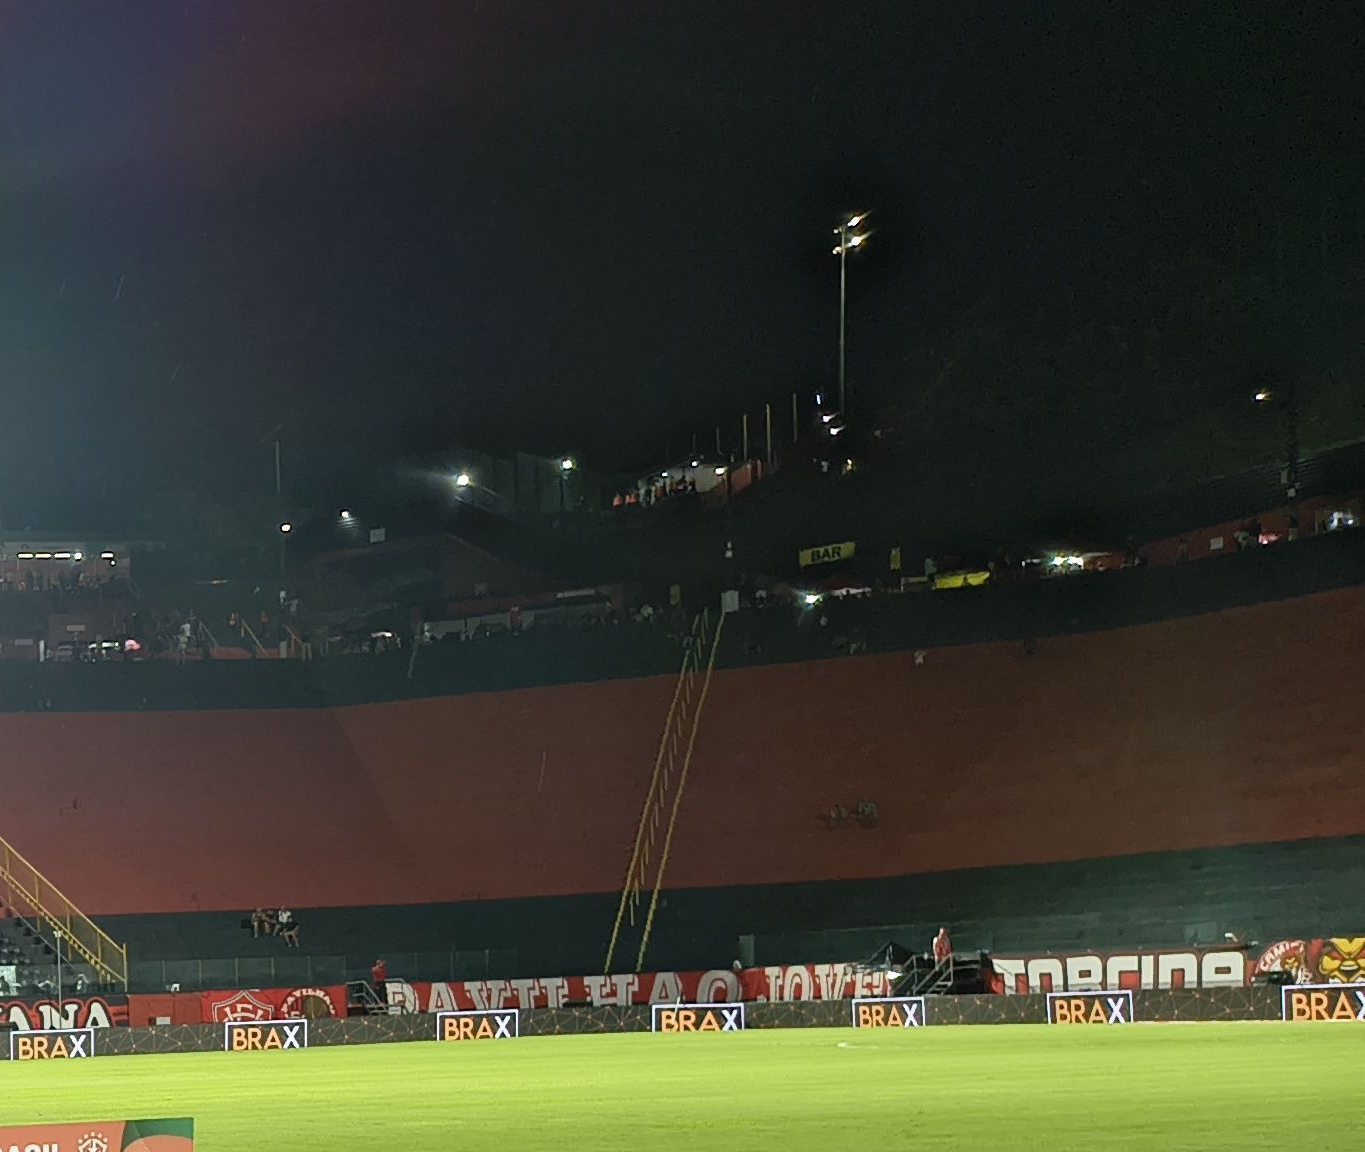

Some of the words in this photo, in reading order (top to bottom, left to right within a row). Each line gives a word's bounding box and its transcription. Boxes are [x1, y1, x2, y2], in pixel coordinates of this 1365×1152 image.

[812, 547, 841, 561] BAR
[660, 1008, 739, 1033] BRAX
[858, 1002, 919, 1028] BRAX
[1054, 997, 1126, 1024] BRAX
[232, 1025, 300, 1051] BRAX
[444, 1015, 512, 1041] BRAX
[20, 1034, 88, 1061] BRAX
